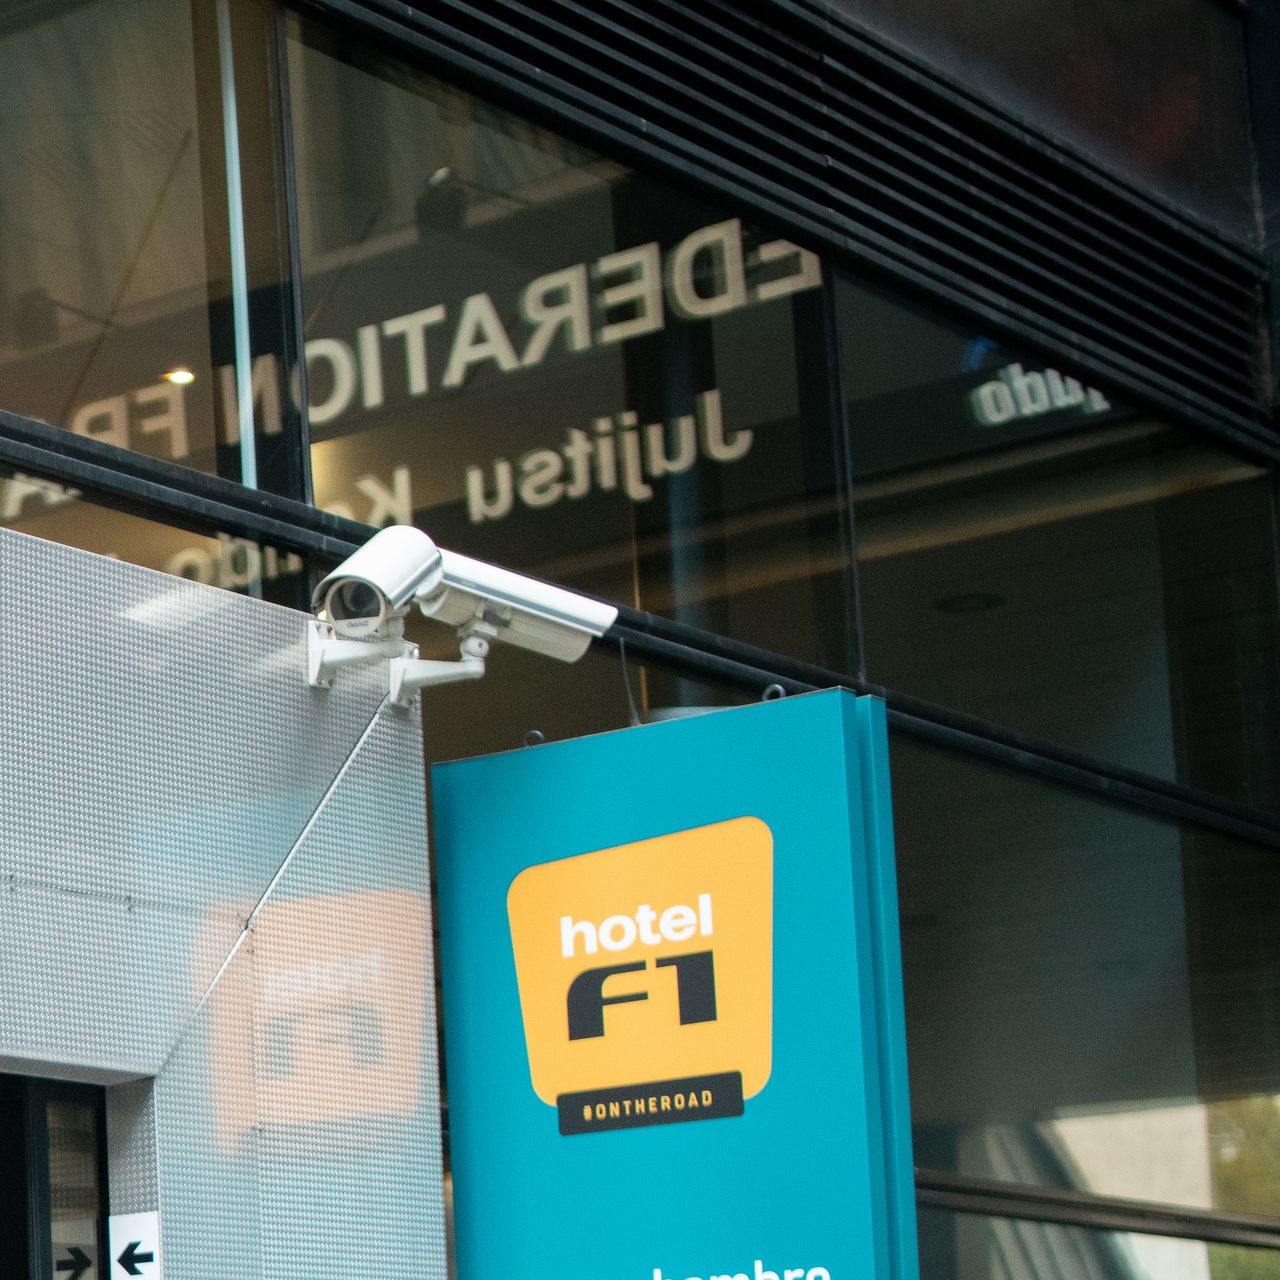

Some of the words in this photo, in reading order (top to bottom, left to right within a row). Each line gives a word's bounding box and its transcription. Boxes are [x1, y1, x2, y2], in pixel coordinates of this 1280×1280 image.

[560, 893, 714, 958] hotel
[566, 949, 718, 1042] F1
[582, 1089, 714, 1121] #ONTHEROAD
